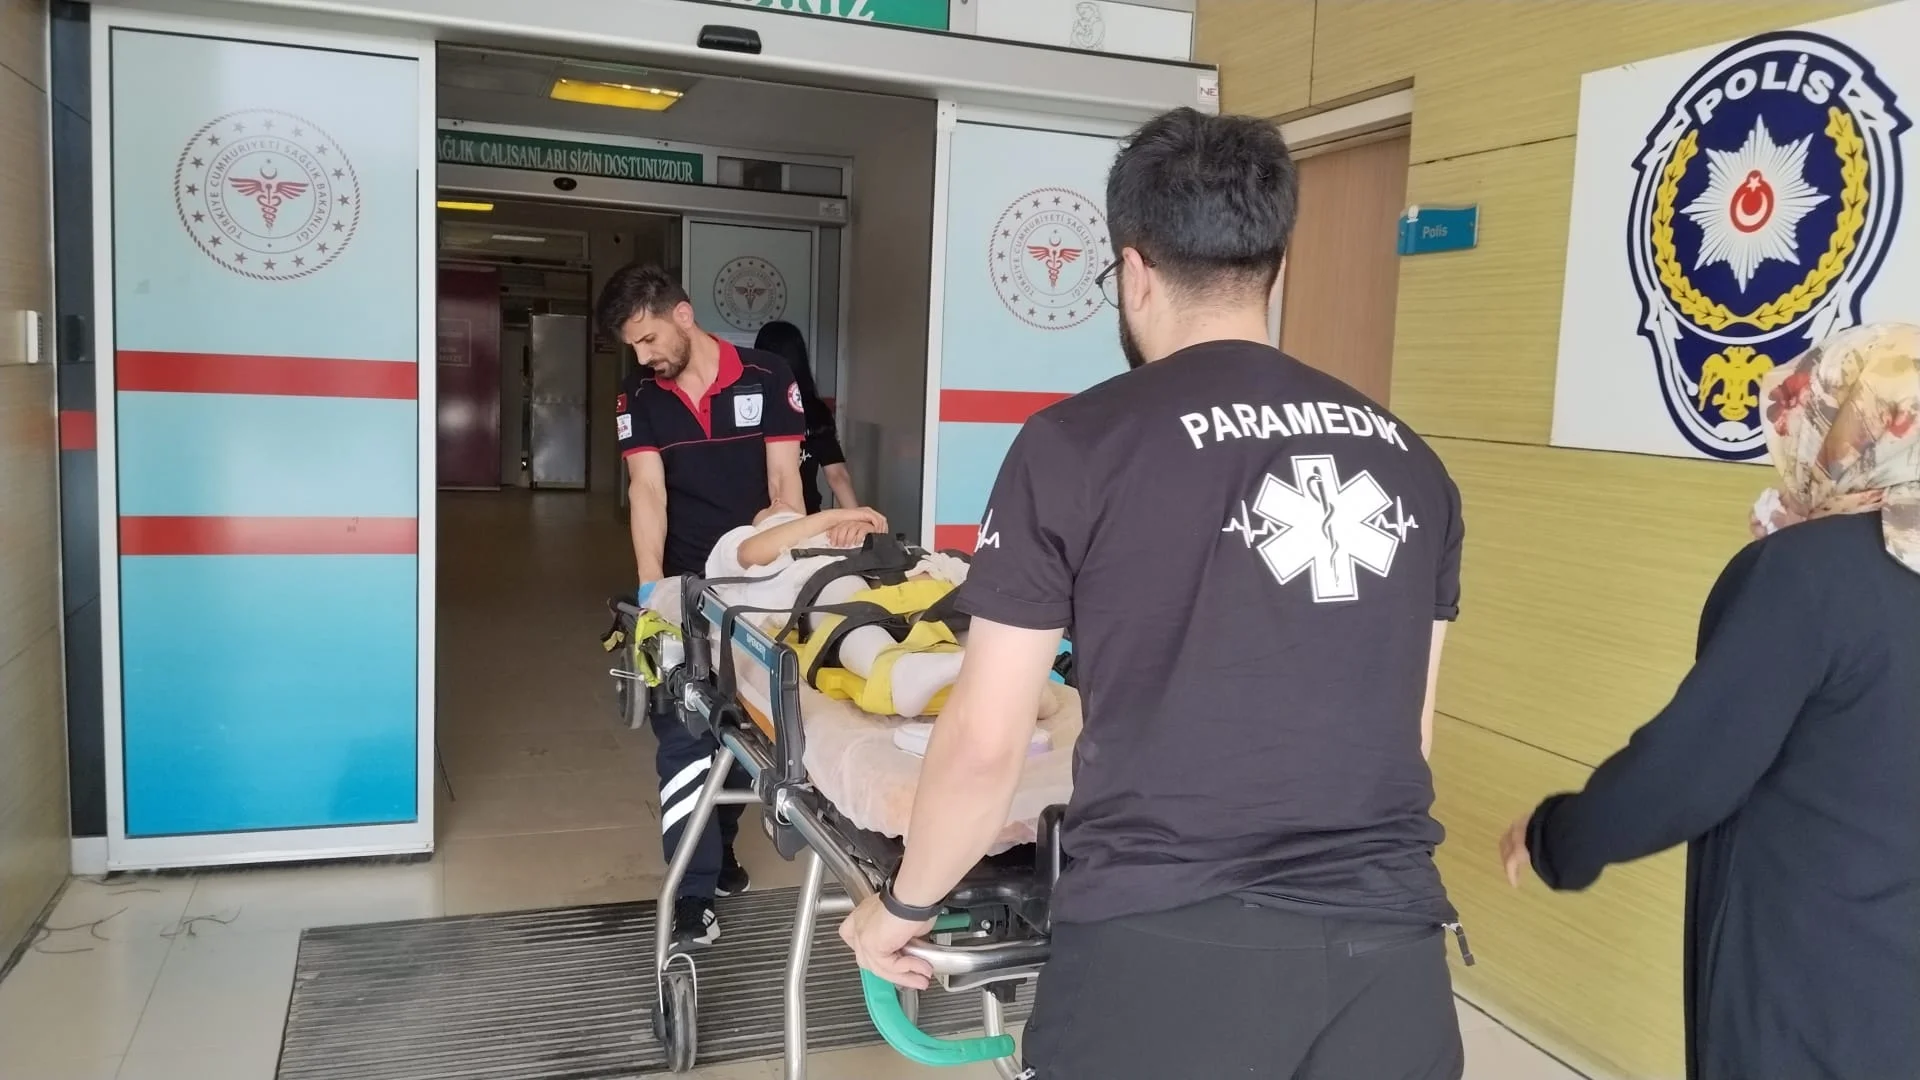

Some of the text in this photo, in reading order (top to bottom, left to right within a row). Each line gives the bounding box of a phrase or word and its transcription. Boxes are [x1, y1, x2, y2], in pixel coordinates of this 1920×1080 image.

[1694, 53, 1835, 126] POLİS
[569, 148, 602, 174] SİZİN
[604, 153, 693, 182] DOSTUNUZDUR
[1423, 224, 1448, 239] Polis
[1180, 402, 1408, 451] PARAMEDİK
